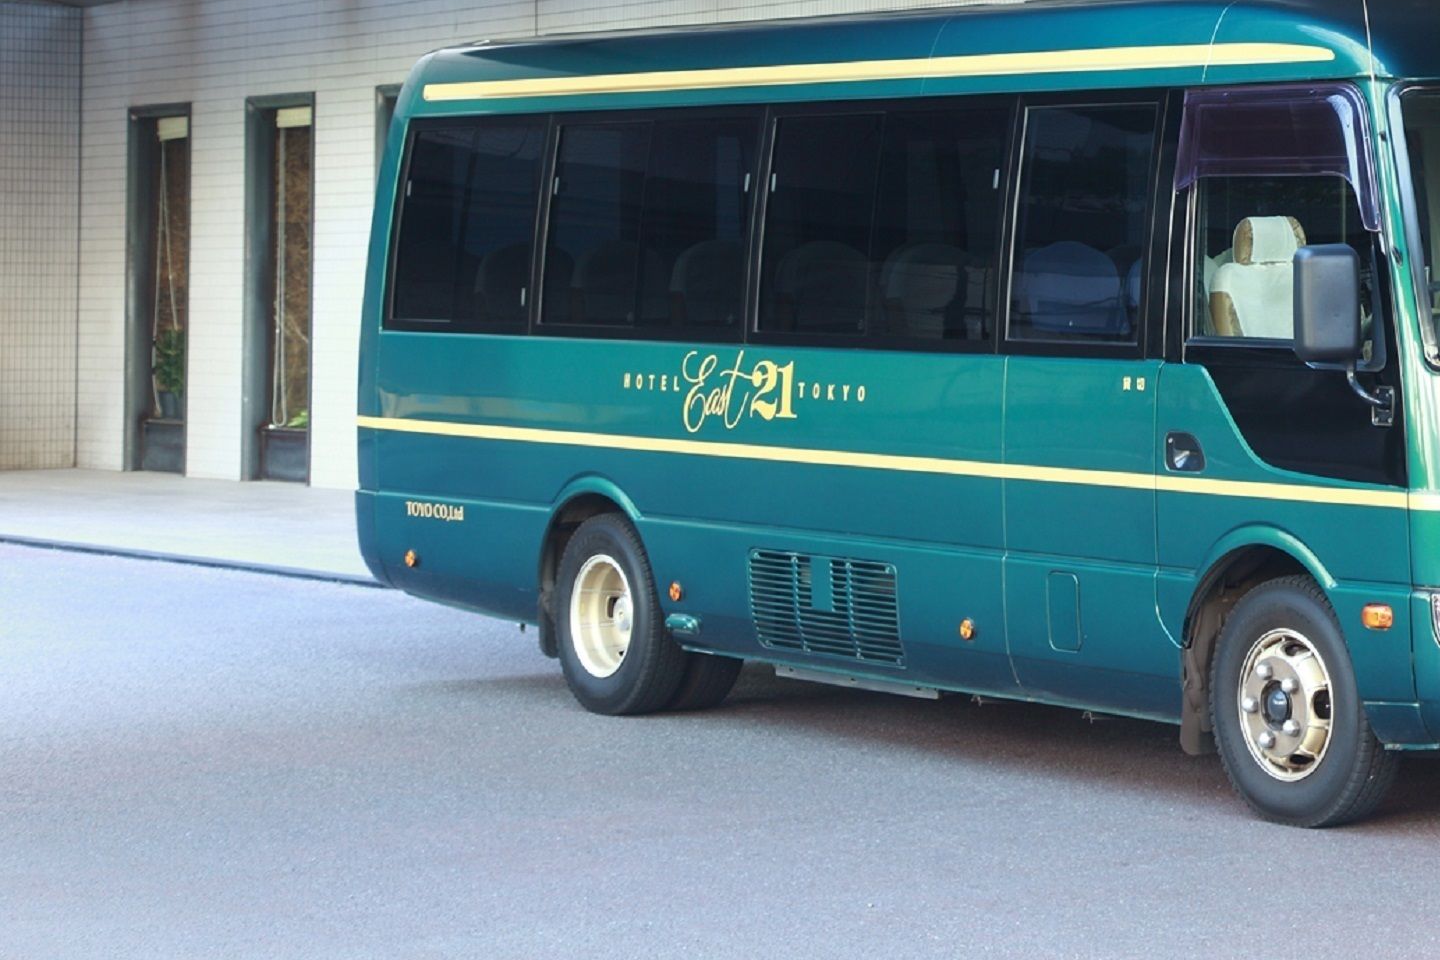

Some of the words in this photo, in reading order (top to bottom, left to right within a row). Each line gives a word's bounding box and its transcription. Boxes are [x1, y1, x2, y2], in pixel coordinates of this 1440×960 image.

[624, 372, 680, 392] HOTEL
[682, 349, 754, 433] East
[750, 359, 798, 421] 21
[798, 381, 866, 403] TOKYO
[405, 501, 432, 518] TOYO
